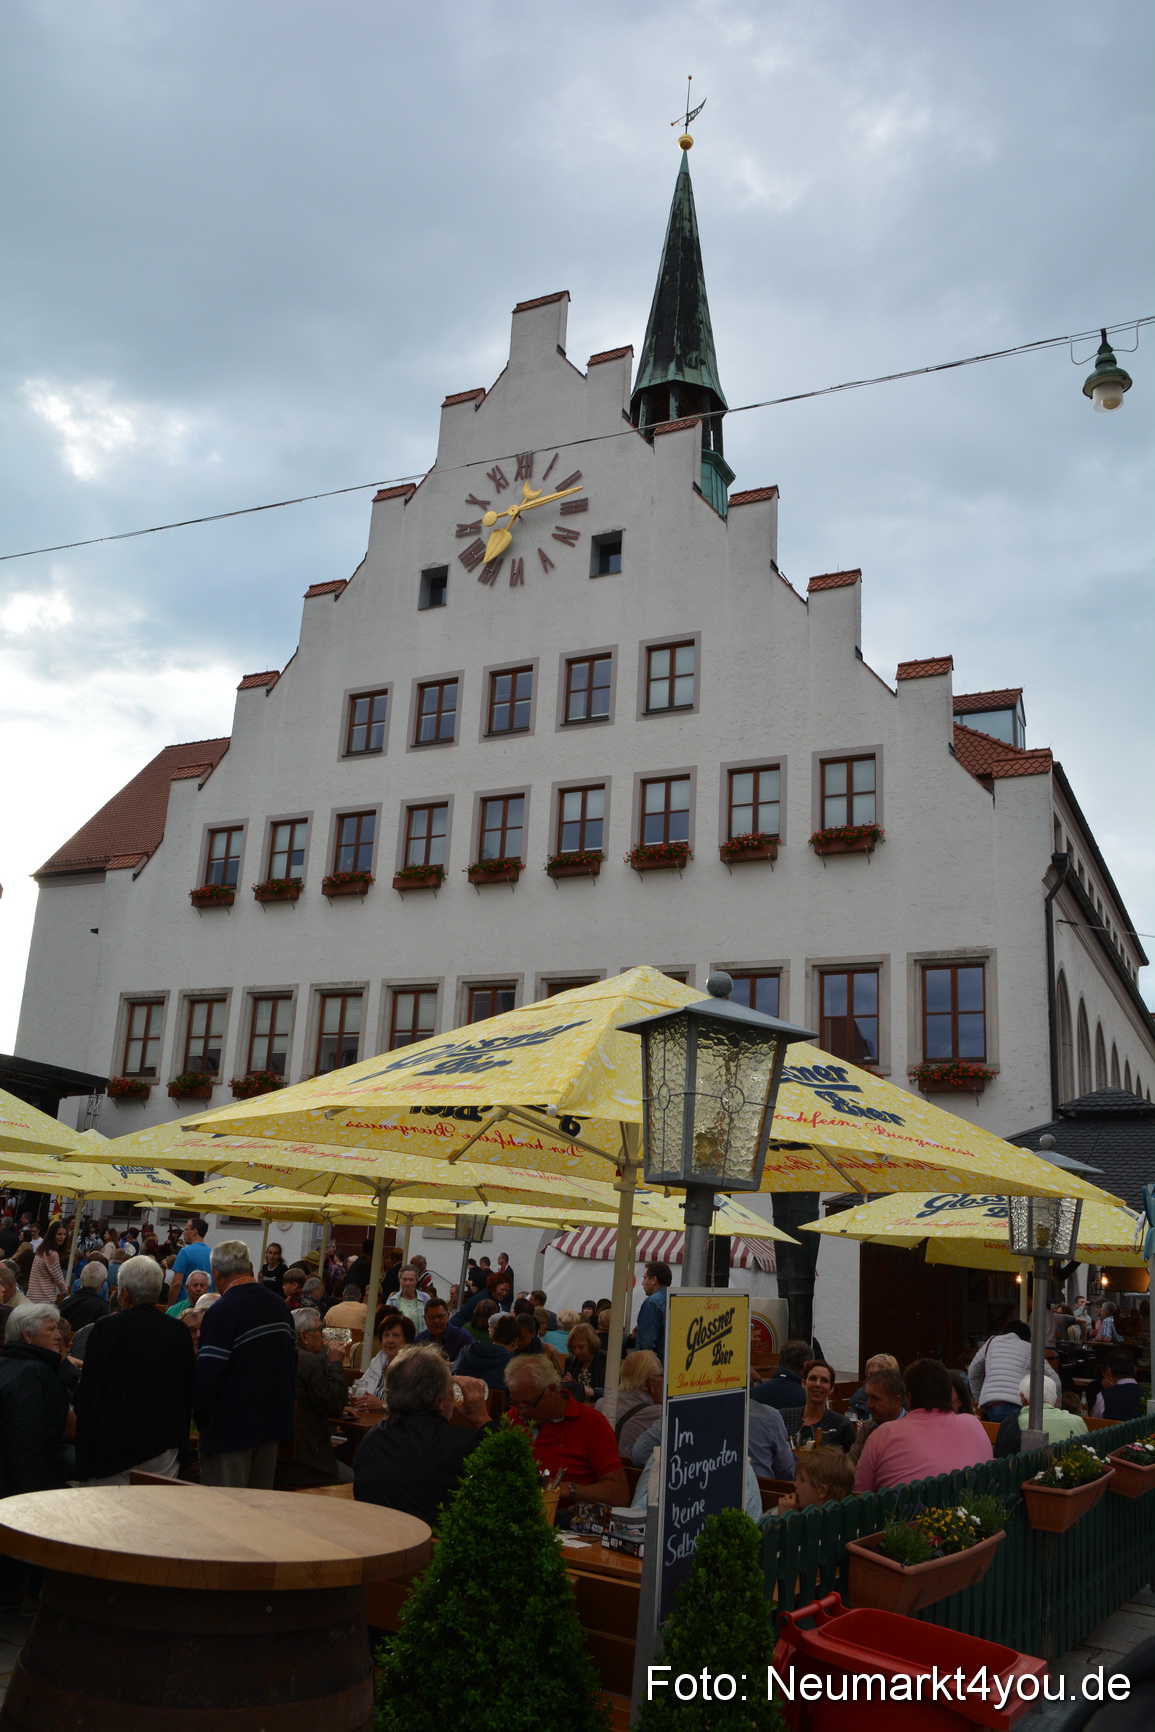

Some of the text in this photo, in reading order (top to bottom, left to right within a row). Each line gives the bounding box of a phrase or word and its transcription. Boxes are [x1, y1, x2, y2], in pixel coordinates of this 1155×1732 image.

[773, 1111, 862, 1130] ochfeine
[814, 1090, 906, 1127] Bier
[686, 1307, 736, 1372] Glossner
[711, 1340, 734, 1367] Bier
[673, 1417, 694, 1452] Im
[668, 1439, 737, 1490] Biergarten
[665, 1522, 705, 1567] Selb
